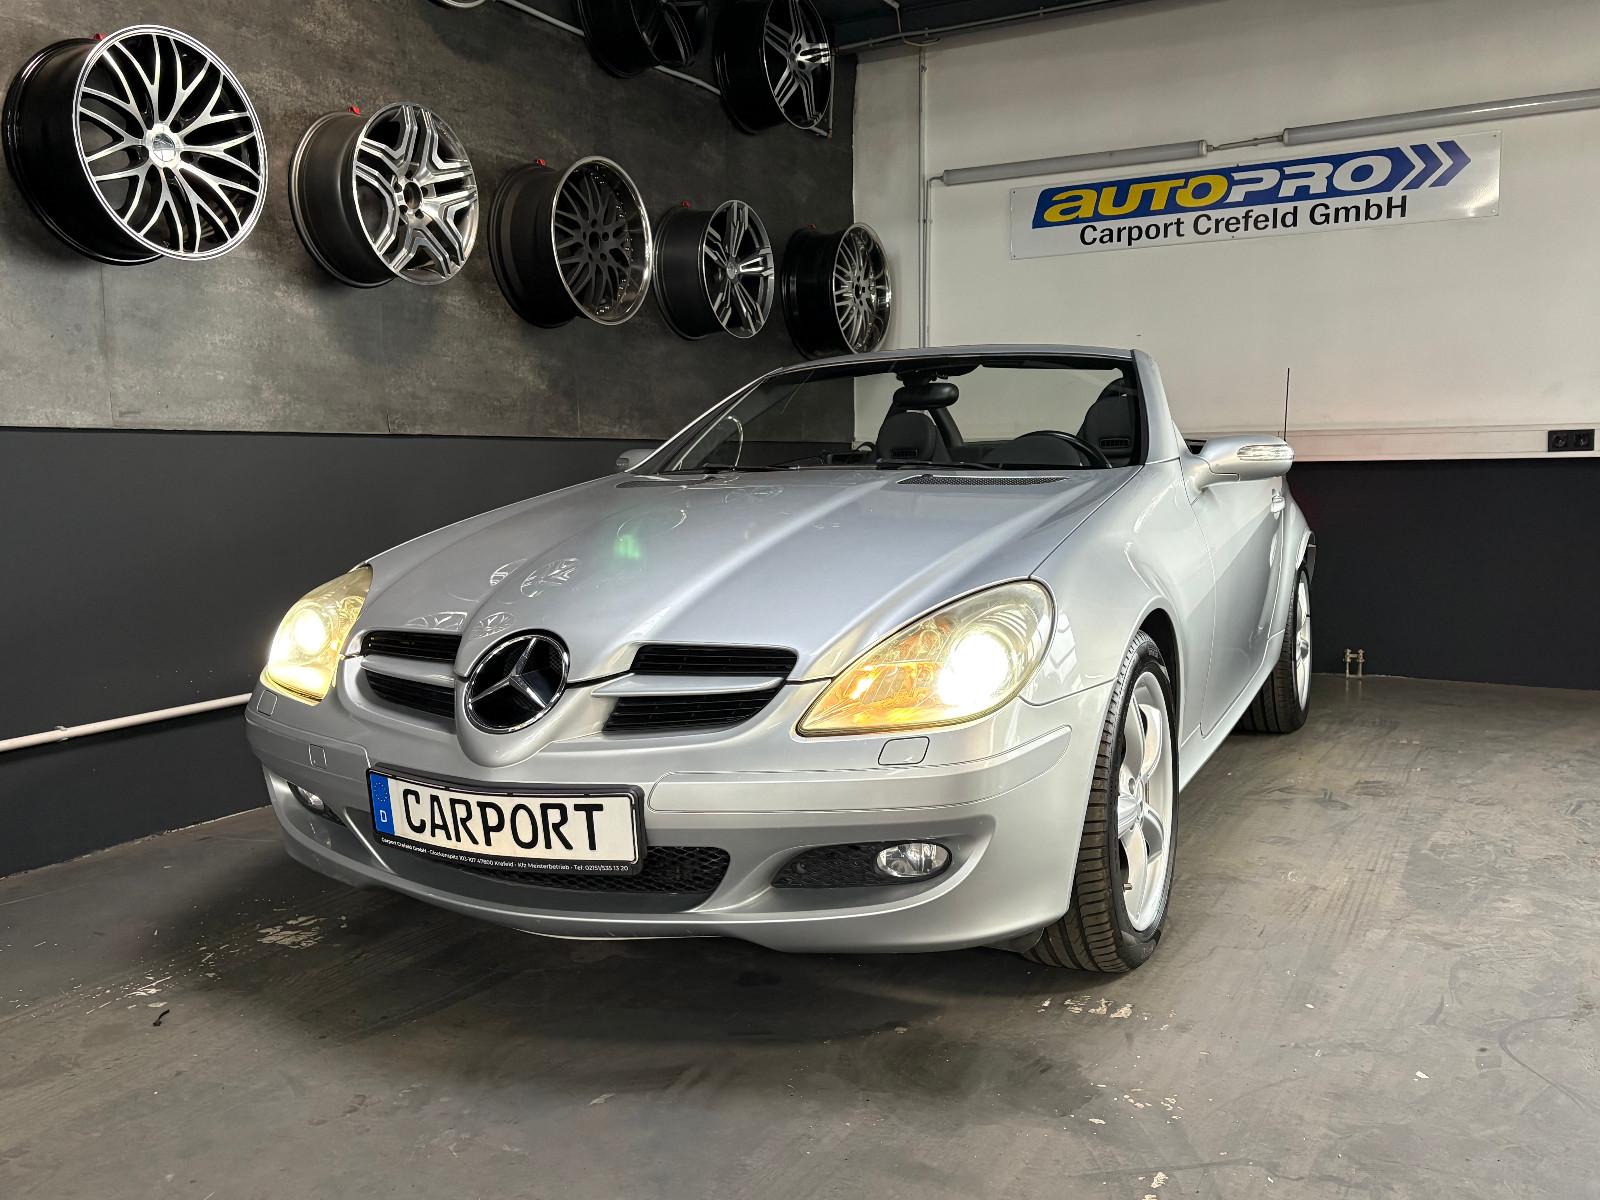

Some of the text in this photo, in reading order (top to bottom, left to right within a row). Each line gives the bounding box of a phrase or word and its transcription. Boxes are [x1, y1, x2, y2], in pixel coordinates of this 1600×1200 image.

[1079, 195, 1408, 246] Carport Crefeld GmbH
[380, 809, 388, 823] D
[402, 788, 604, 851] CARPORT
